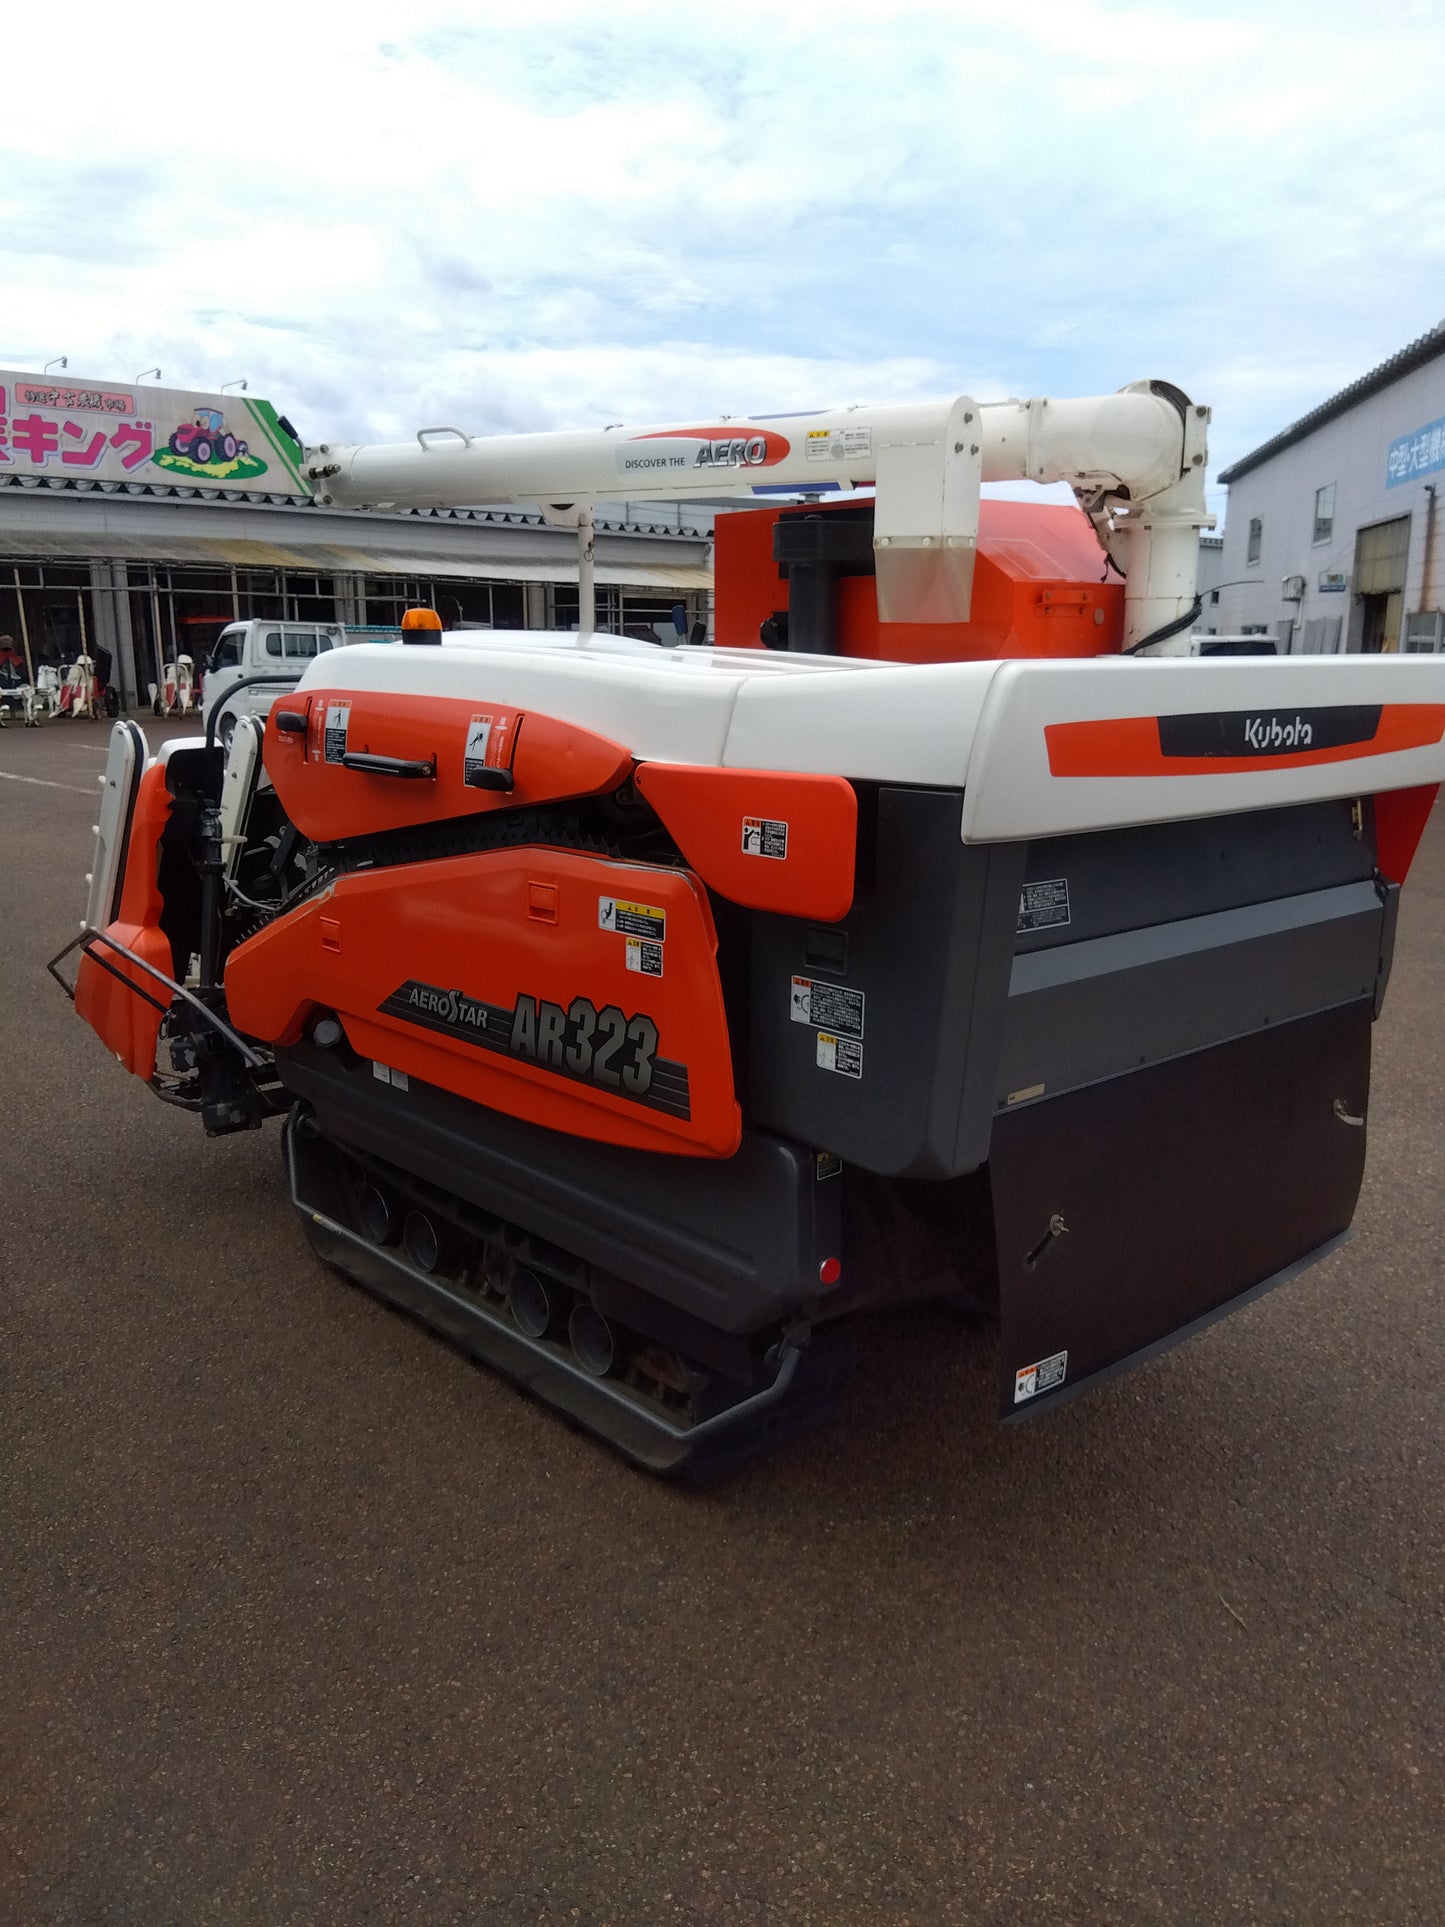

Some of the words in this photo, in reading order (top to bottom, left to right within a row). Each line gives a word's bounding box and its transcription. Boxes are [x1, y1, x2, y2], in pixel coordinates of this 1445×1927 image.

[625, 459, 667, 469] DISCOVER
[669, 457, 685, 466] THE
[693, 436, 768, 468] AERO
[1244, 716, 1313, 749] Kubota
[509, 995, 660, 1096] AR323
